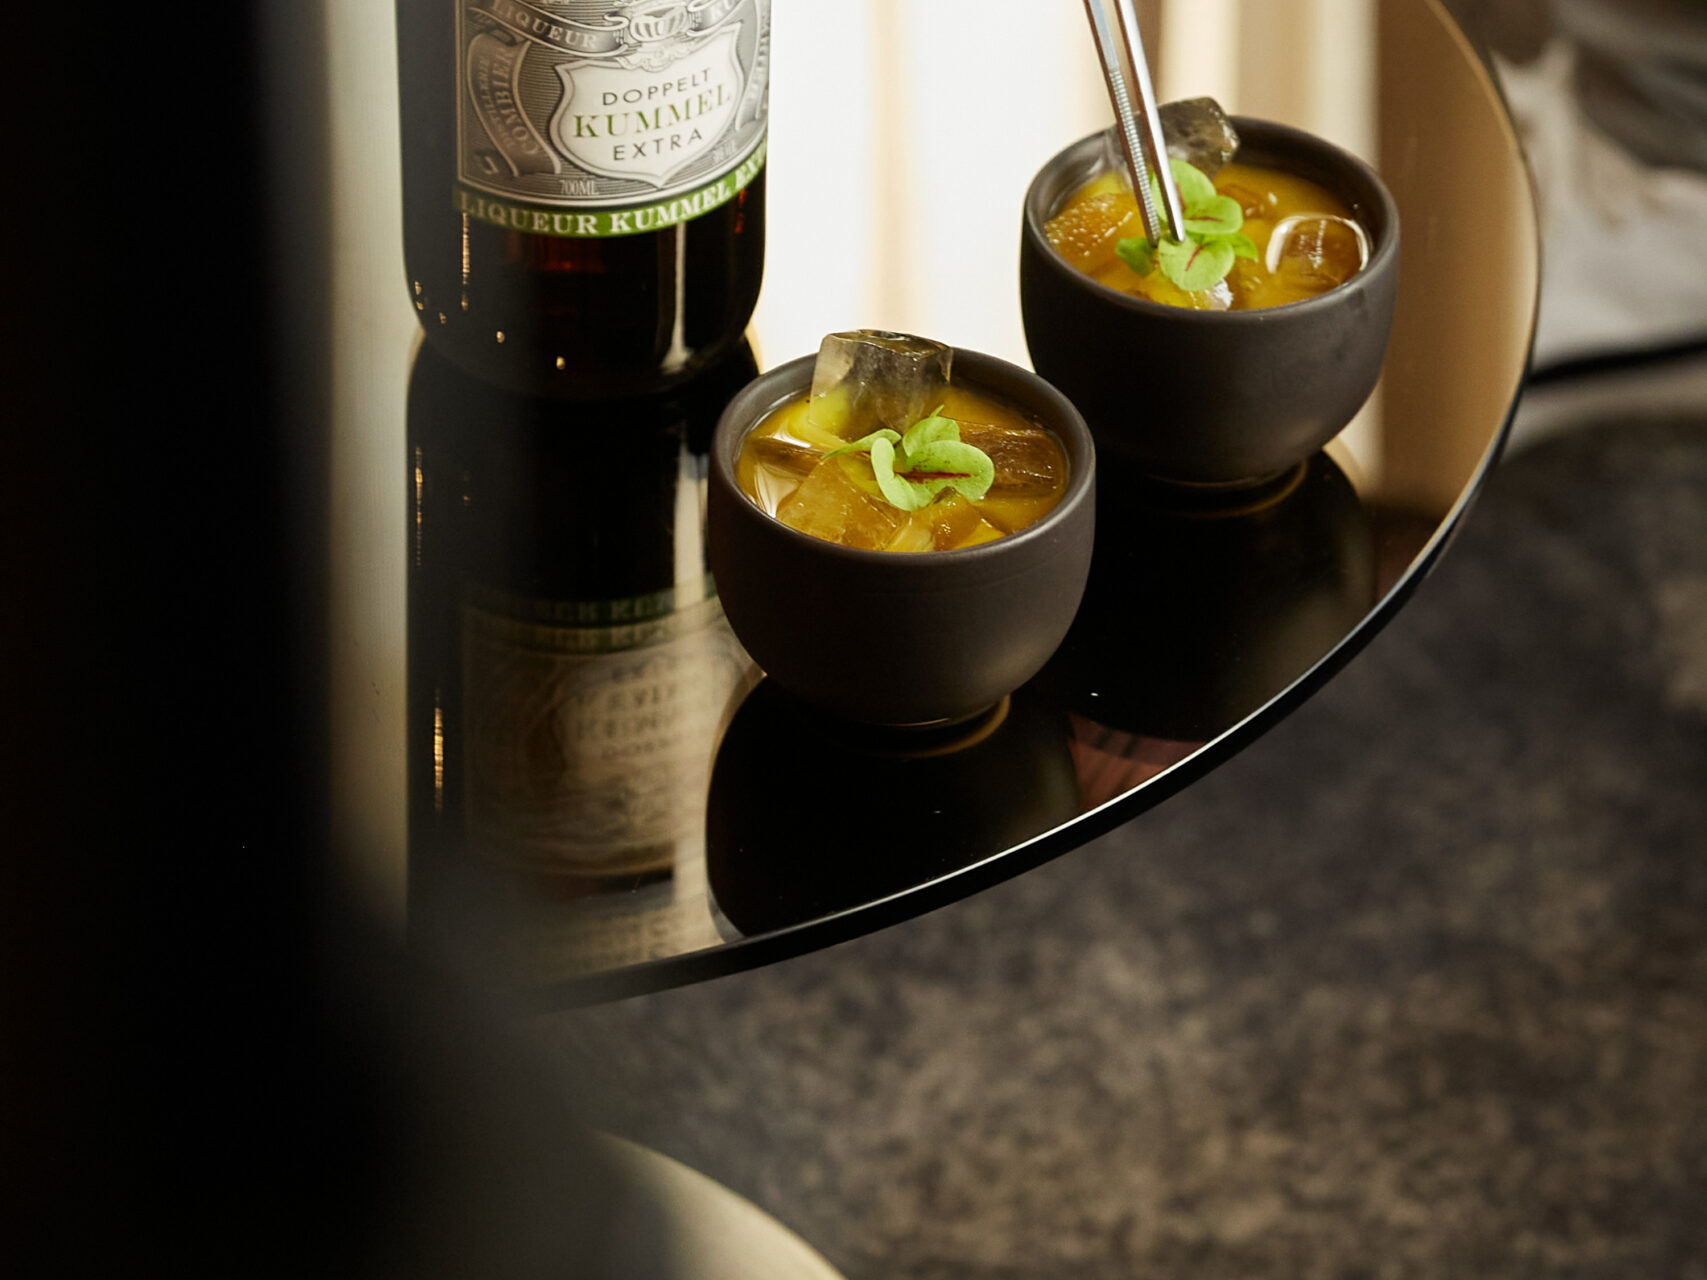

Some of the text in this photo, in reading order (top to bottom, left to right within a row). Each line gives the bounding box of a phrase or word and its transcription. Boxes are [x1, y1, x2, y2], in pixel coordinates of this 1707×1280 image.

[493, 46, 541, 155] COMBIER
[573, 84, 732, 138] KUMMEL
[602, 67, 712, 106] DOPPELT
[613, 127, 703, 161] EXTRA
[461, 191, 598, 235] LIQUEUR
[609, 182, 732, 233] KUMMEL
